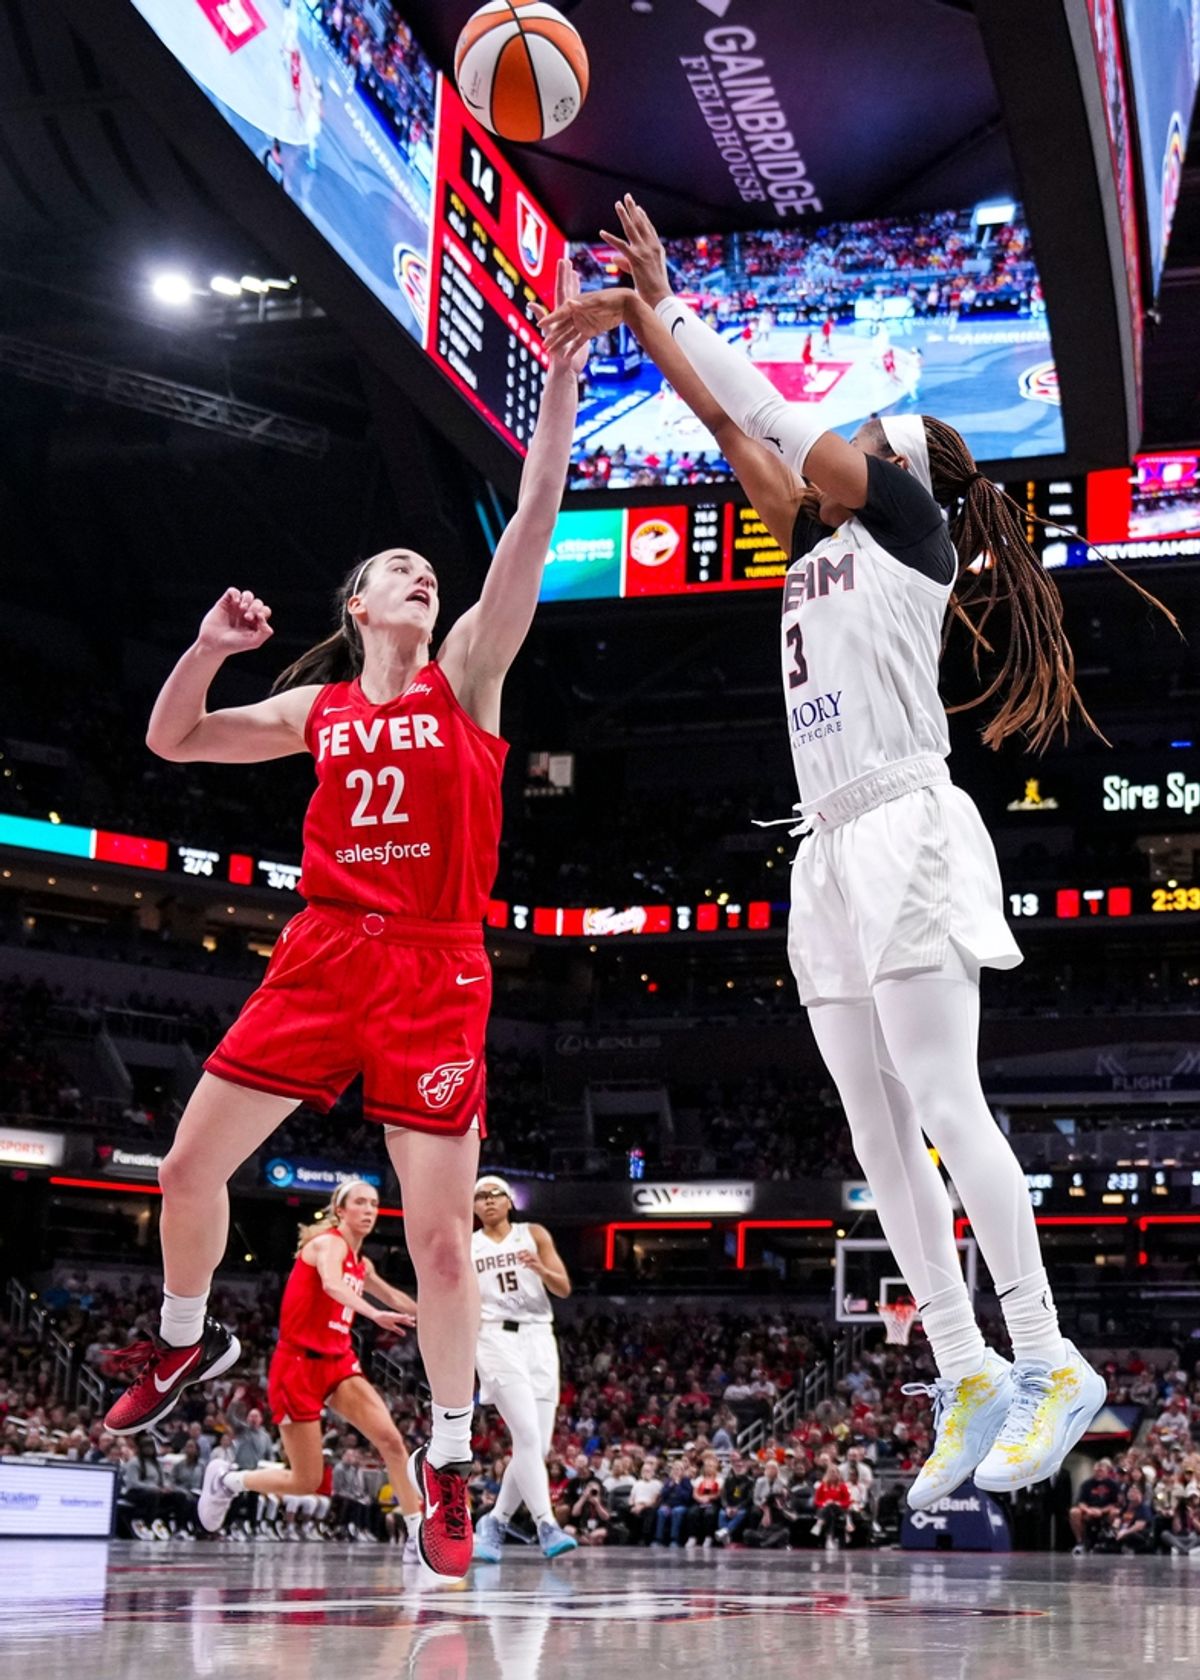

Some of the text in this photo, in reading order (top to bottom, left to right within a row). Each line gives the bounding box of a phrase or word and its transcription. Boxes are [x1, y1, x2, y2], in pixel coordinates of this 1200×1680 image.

[679, 54, 766, 202] FIELDHOUSE
[703, 25, 823, 217] GAINBRIDGE
[470, 147, 495, 204] 14
[786, 622, 808, 689] 3
[318, 714, 445, 763] FEVER
[345, 766, 409, 827] 22
[1103, 775, 1160, 812] Sire
[335, 841, 431, 865] salesforce
[183, 857, 213, 876] 2/4
[267, 870, 296, 891] 3/4
[1009, 893, 1039, 917] 13
[1151, 887, 1200, 911] 2:33
[1112, 1075, 1174, 1091] FLIGHT
[296, 1167, 334, 1182] Sports
[475, 1249, 529, 1274] DREA
[496, 1270, 519, 1293] 15
[926, 1496, 980, 1514] yBank
